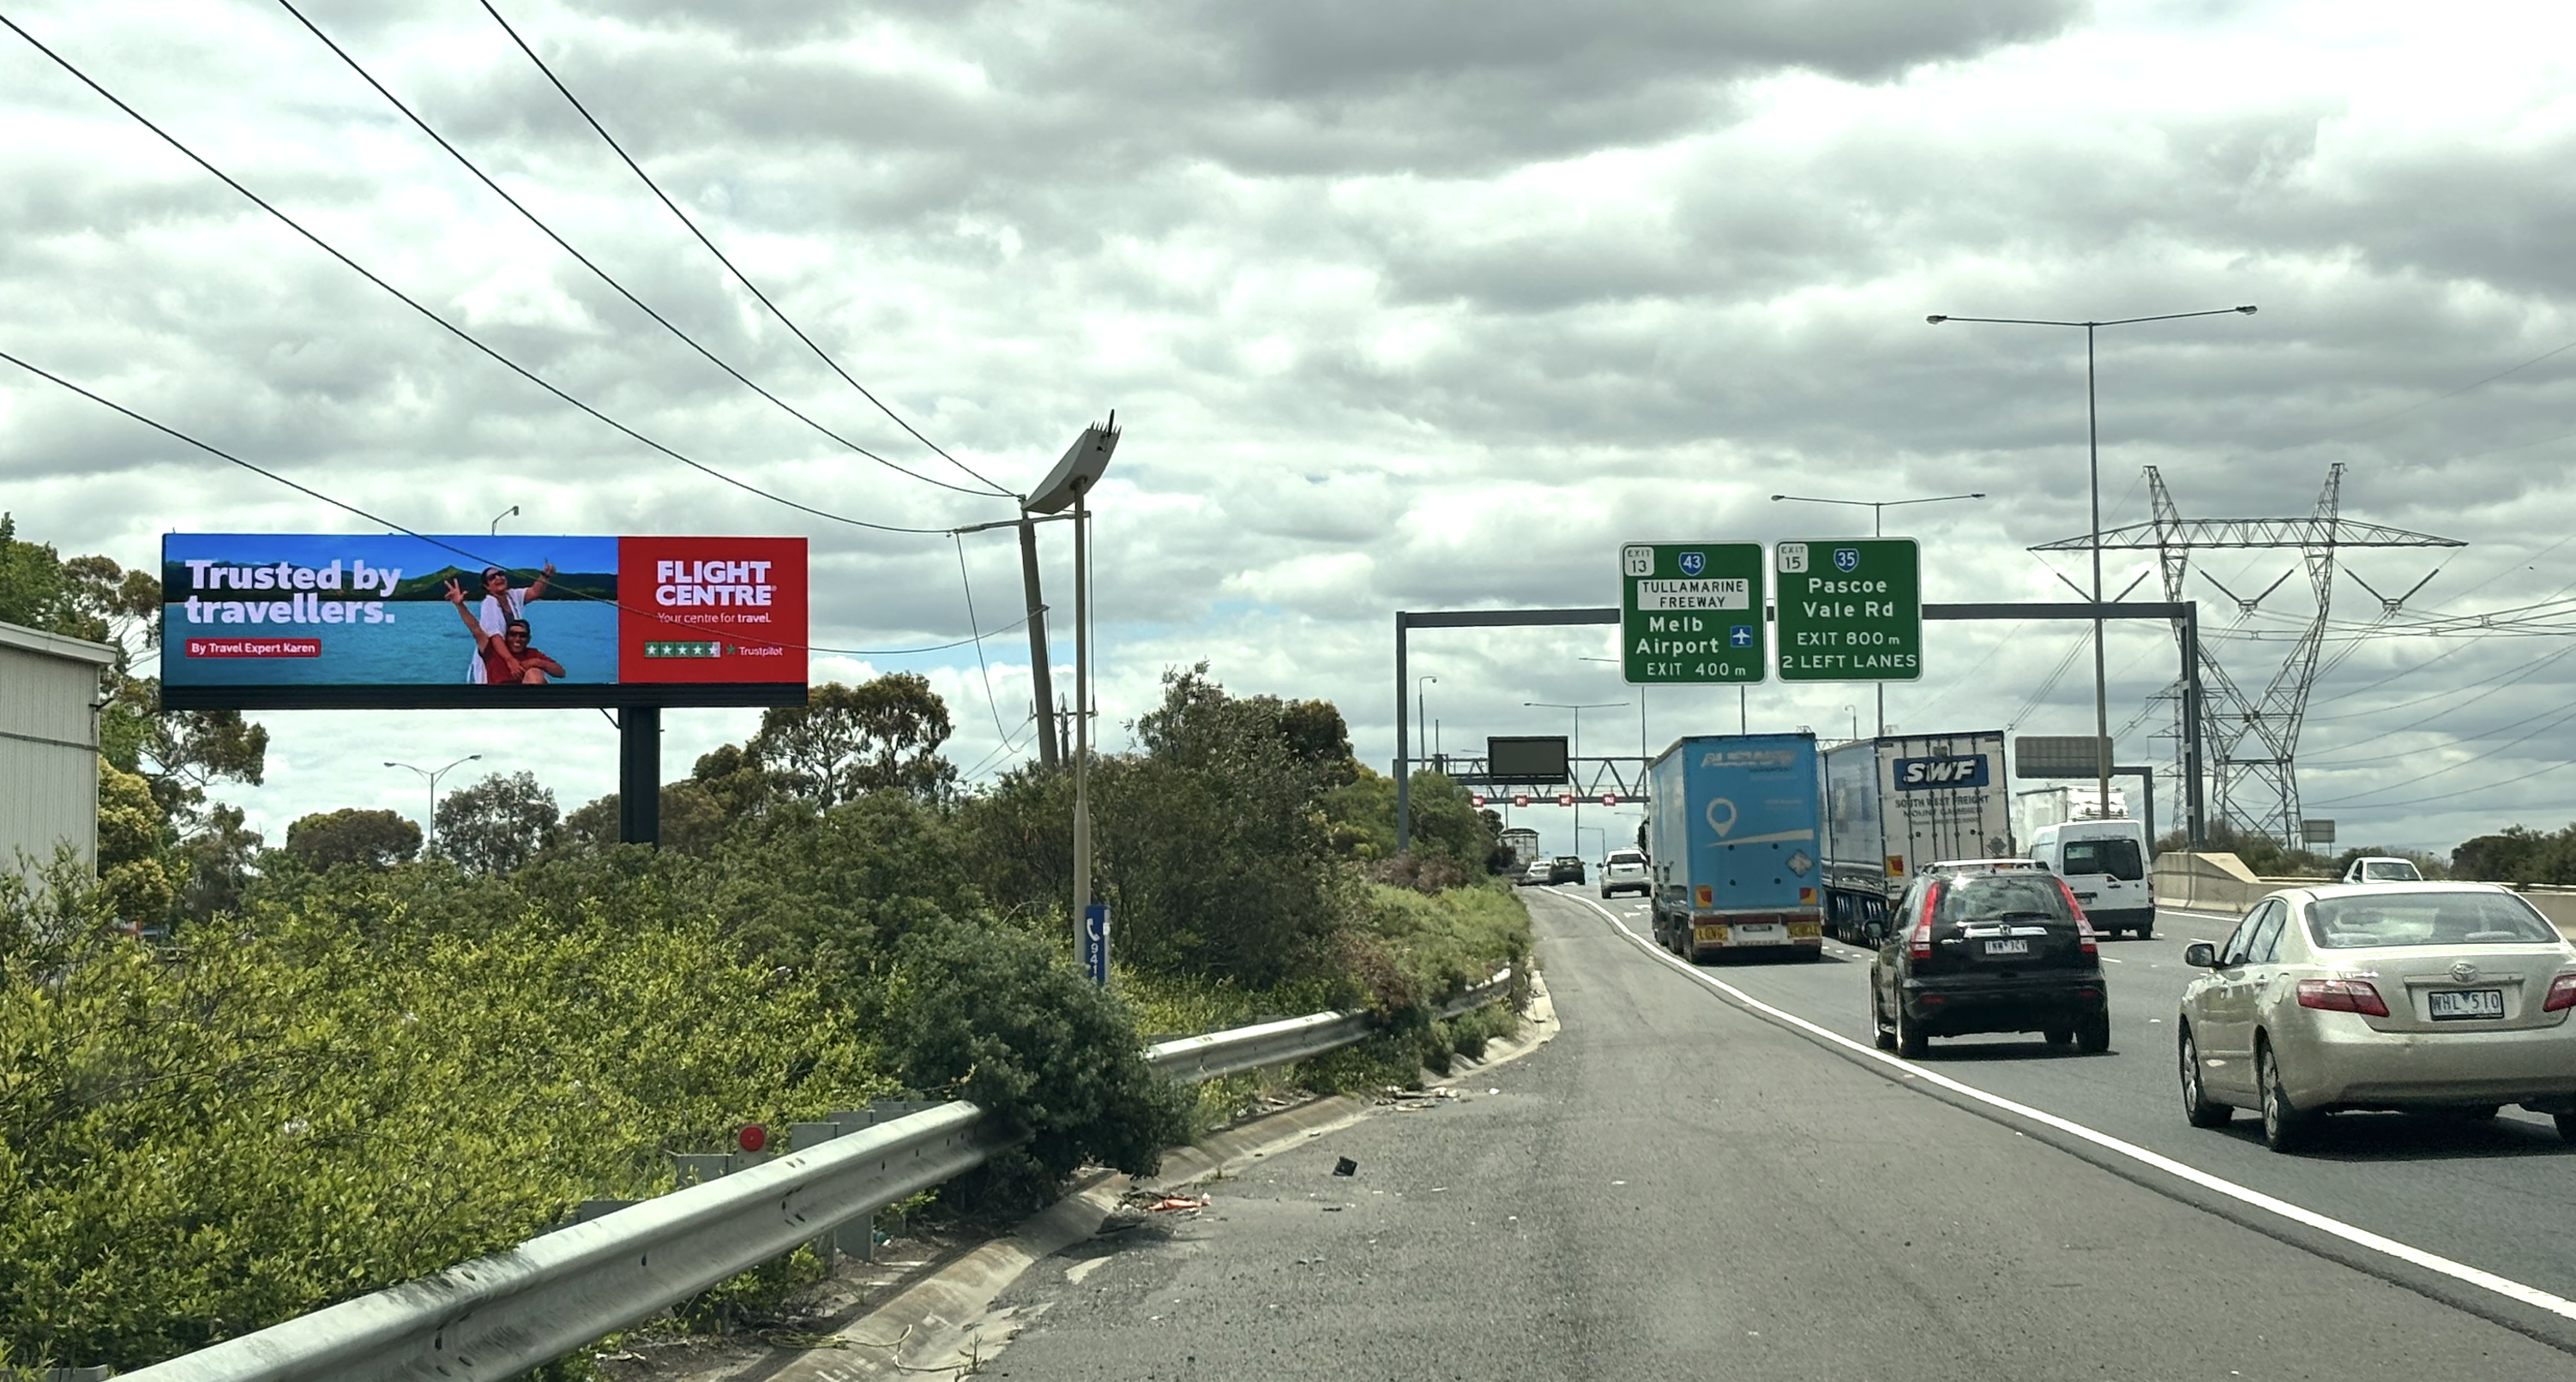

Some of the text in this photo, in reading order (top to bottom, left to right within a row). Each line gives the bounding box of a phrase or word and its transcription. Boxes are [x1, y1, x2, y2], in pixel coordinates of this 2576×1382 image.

[1683, 556, 1701, 568] 43
[1785, 556, 1801, 569] 15
[1838, 552, 1856, 566] 35
[657, 561, 772, 583] FLIGHT
[1632, 560, 1647, 573] 13
[185, 559, 402, 597] Trusted by
[1642, 581, 1743, 592] TULLAMARINE
[1809, 578, 1887, 593] Pascoe
[656, 585, 772, 606] CENTRE
[1660, 597, 1725, 608] FREEWAY
[185, 592, 395, 624] travellers.
[1803, 601, 1893, 617] Vale Rd
[658, 612, 682, 622] Your
[683, 612, 719, 623] centre
[720, 612, 735, 623] for
[1649, 616, 1703, 632] Melb
[1797, 632, 1899, 646] EXIT 800 m
[191, 642, 316, 655] By Travel Expert Karen
[739, 646, 783, 656] Trustpilot
[1635, 638, 1718, 657] Airport
[1782, 654, 1917, 668] 2 LEFT LANES
[1647, 663, 1746, 676] EXIT 400 m
[1903, 759, 1976, 783] SWF
